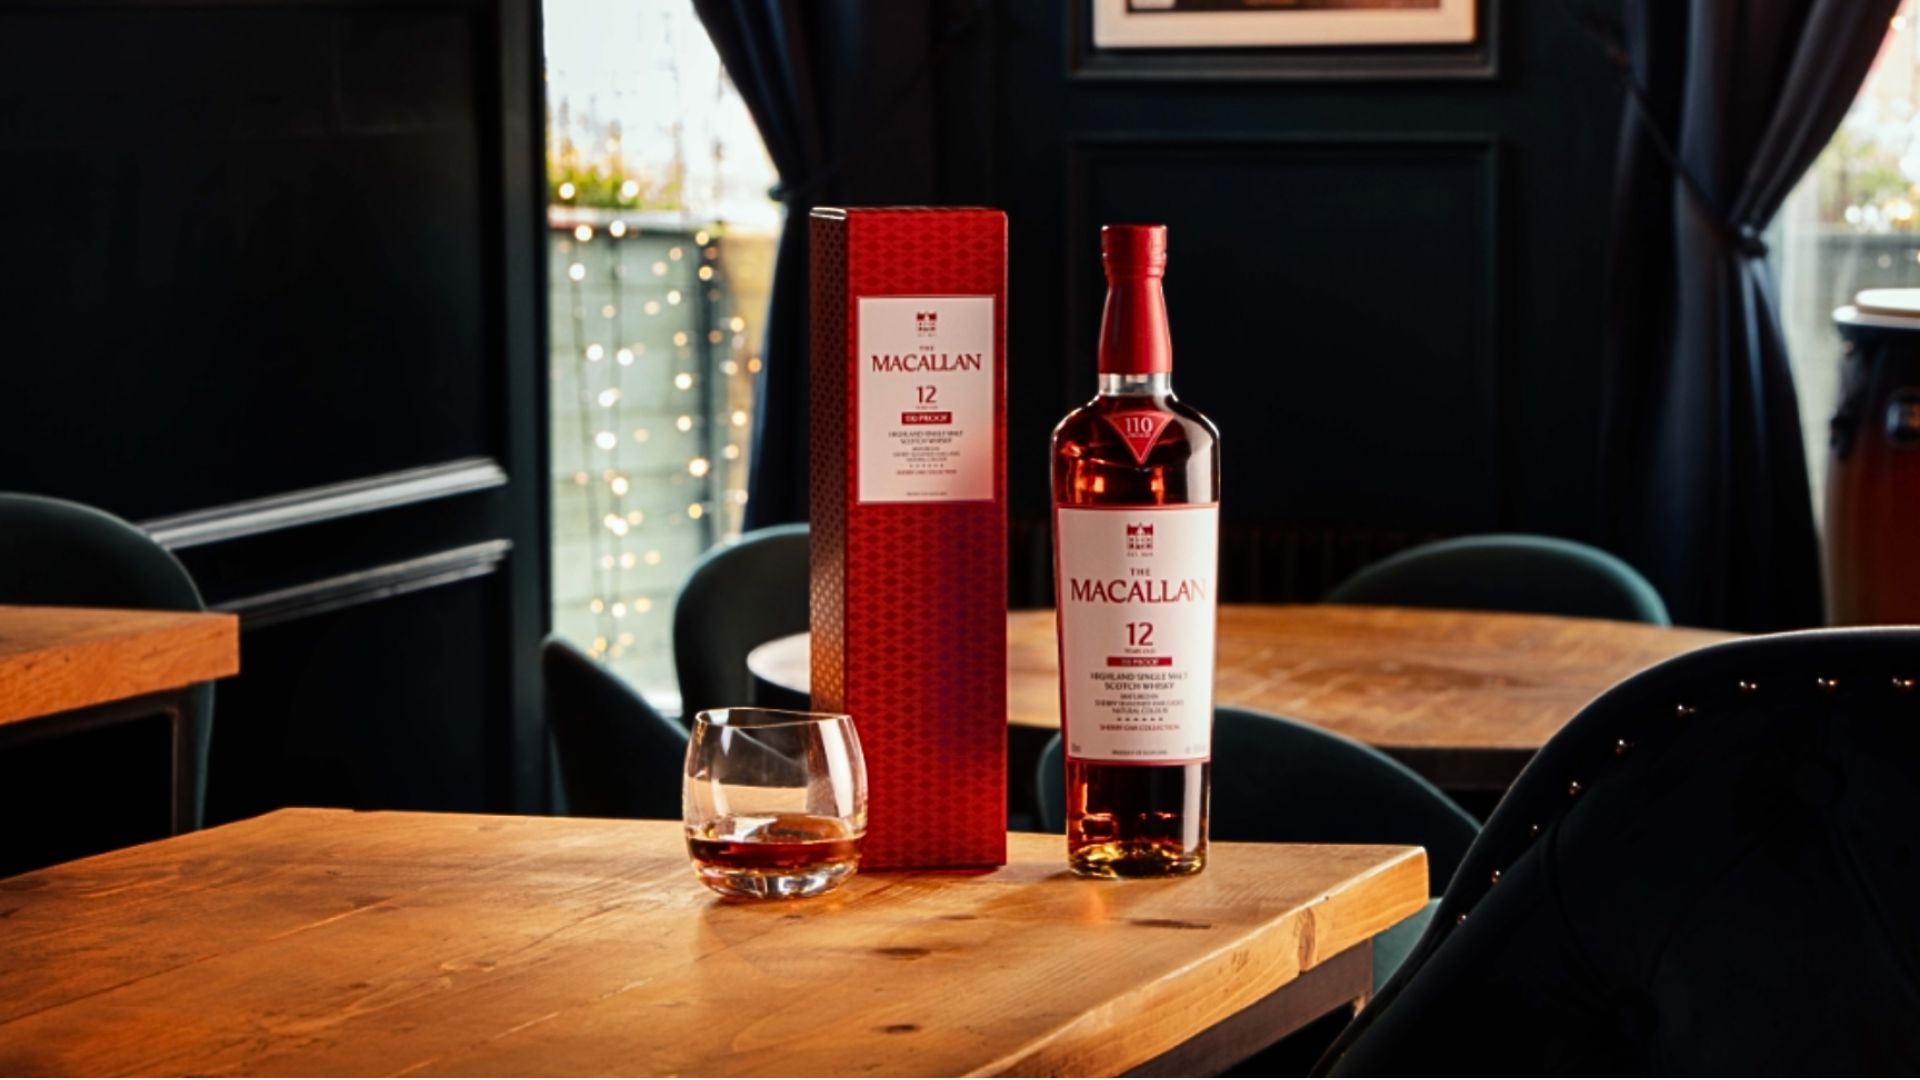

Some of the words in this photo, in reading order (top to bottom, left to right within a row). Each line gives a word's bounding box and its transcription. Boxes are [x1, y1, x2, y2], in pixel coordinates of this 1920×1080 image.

[871, 353, 982, 372] MACALLAN
[916, 385, 937, 404] 12
[1125, 417, 1153, 433] 110
[1129, 568, 1151, 577] THE
[1070, 578, 1206, 603] MACALLAN
[1125, 621, 1154, 646] 12
[1090, 672, 1135, 681] HIGHLAND
[1136, 672, 1166, 681] SINGLE
[1104, 682, 1141, 690] SCOTCH
[1143, 682, 1175, 690] WHISKY
